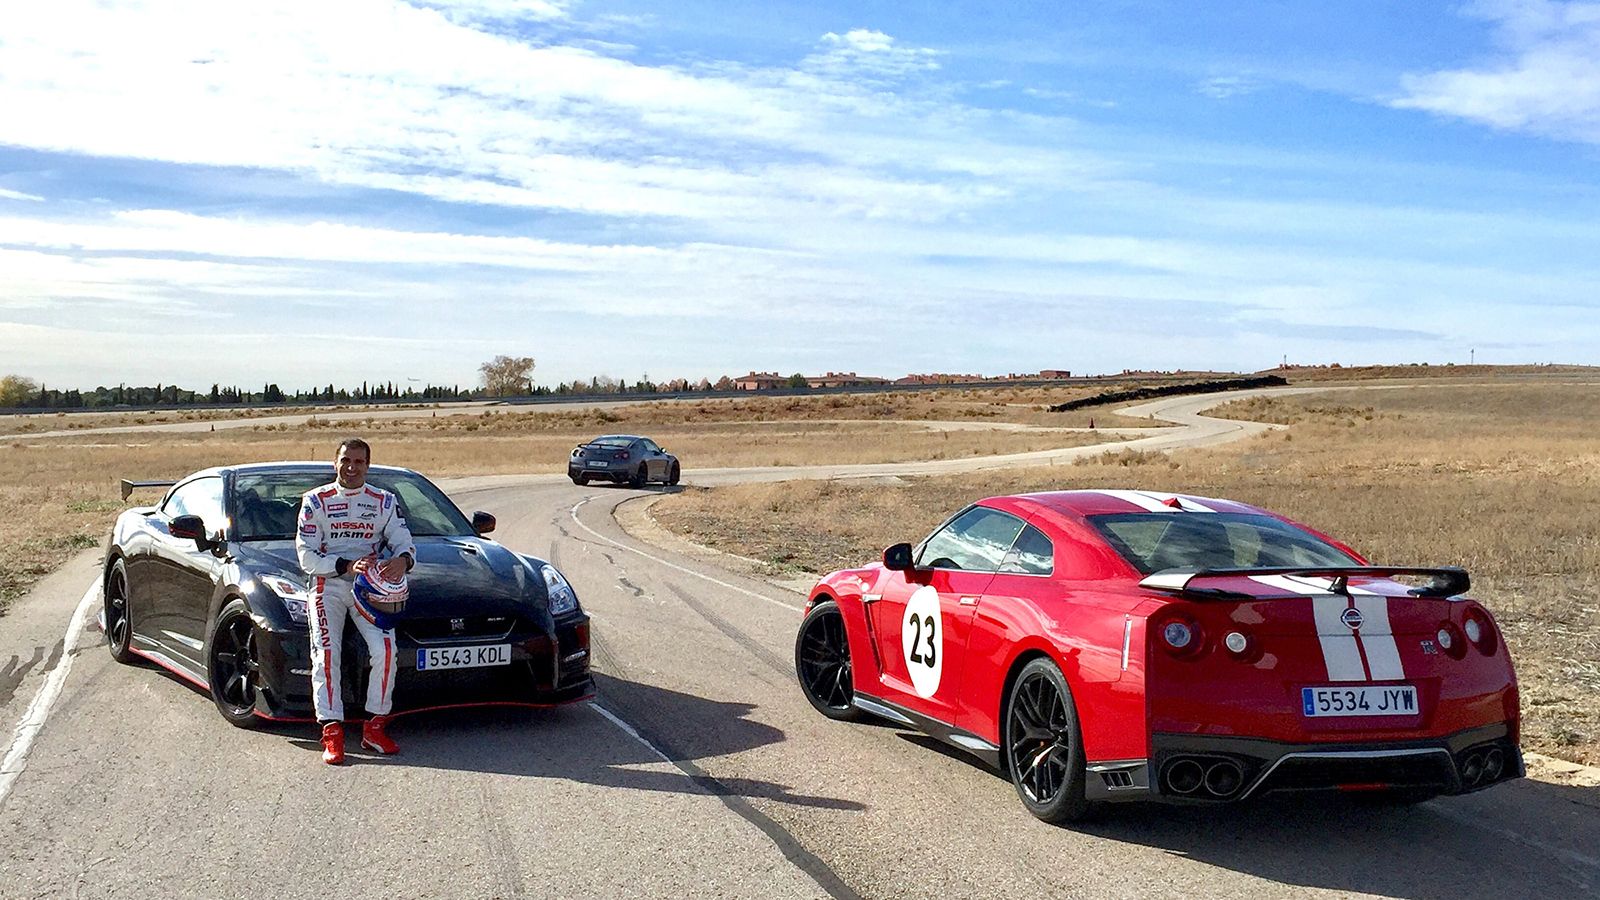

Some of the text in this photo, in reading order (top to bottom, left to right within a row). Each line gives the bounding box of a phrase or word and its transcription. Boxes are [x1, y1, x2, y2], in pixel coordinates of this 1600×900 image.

[330, 521, 374, 530] NISSAN
[315, 597, 331, 647] NISSAN
[909, 612, 936, 668] 23
[430, 647, 507, 666] 5543 KDL
[1317, 690, 1414, 712] 5534 JYW
